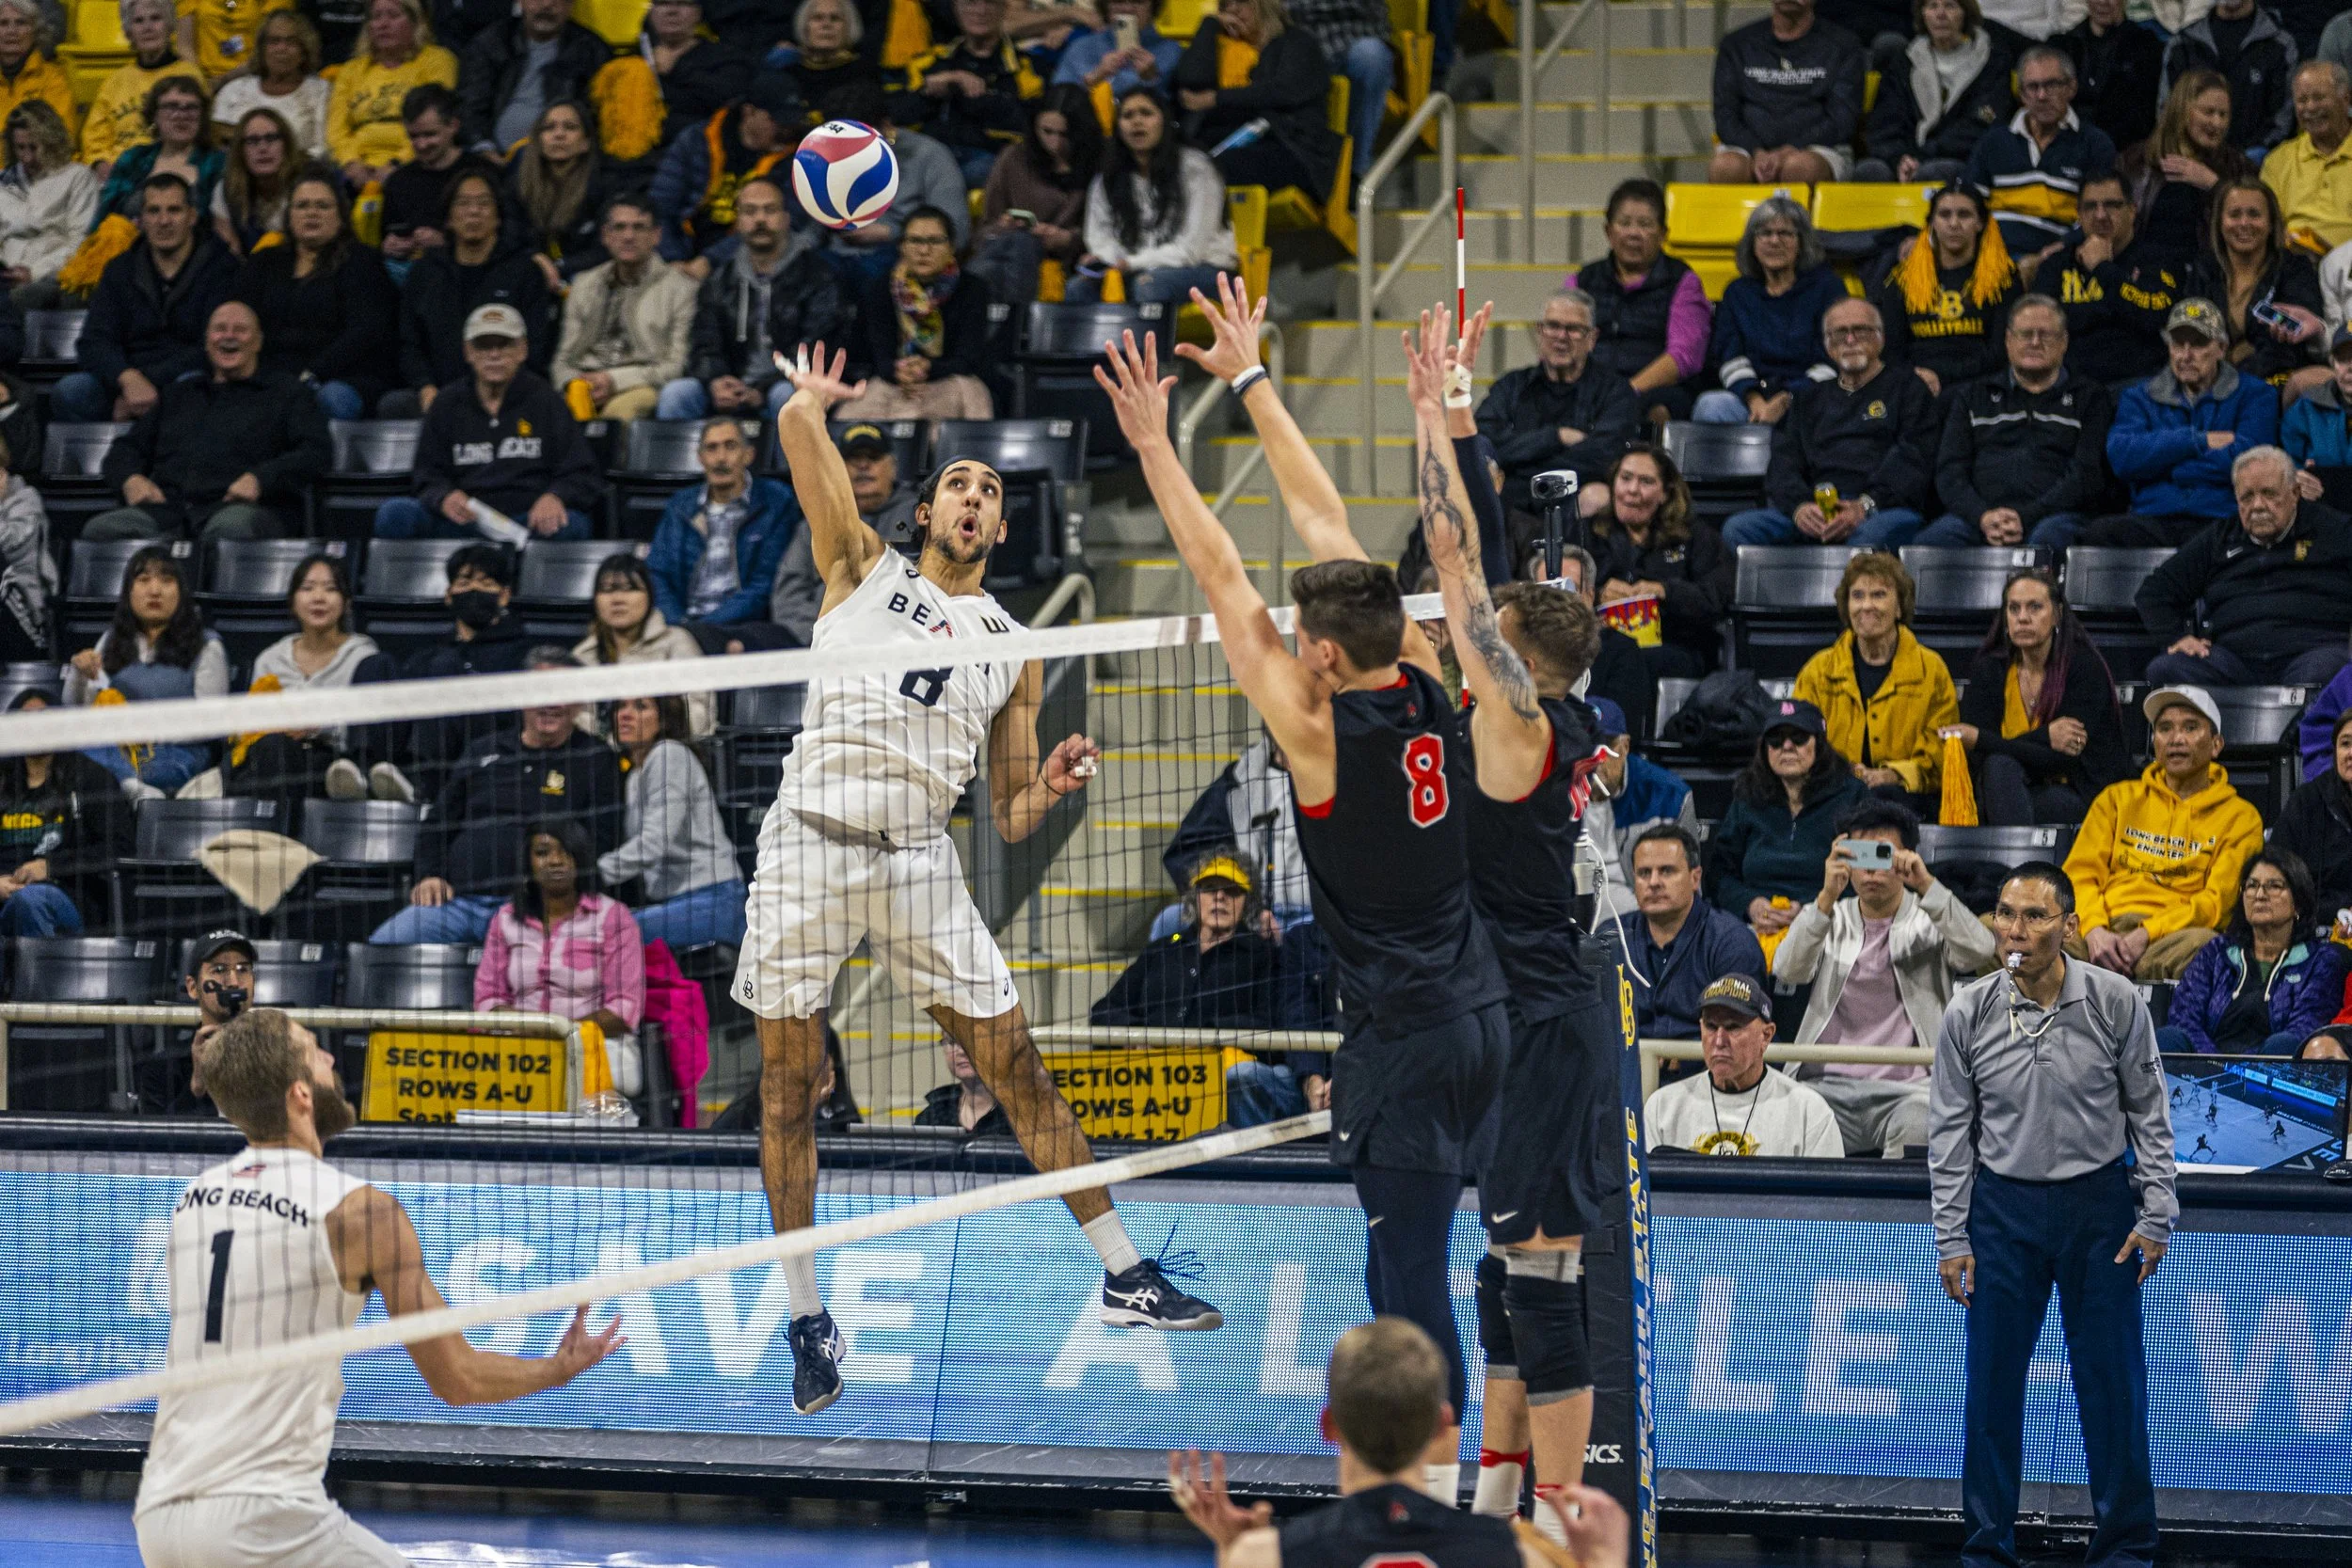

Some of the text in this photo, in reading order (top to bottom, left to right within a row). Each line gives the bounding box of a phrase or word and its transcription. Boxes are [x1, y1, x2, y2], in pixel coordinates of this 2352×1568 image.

[1401, 732, 1450, 829] 8
[386, 1046, 551, 1074] SECTION 102
[398, 1078, 533, 1103] ROWS A-U
[1053, 1065, 1208, 1088] ECTION 103
[398, 1108, 456, 1124] Seat
[1071, 1097, 1192, 1118] OWS A-U
[229, 1188, 309, 1227] BEACH
[205, 1229, 234, 1343] 1
[446, 1234, 924, 1385] SAVE
